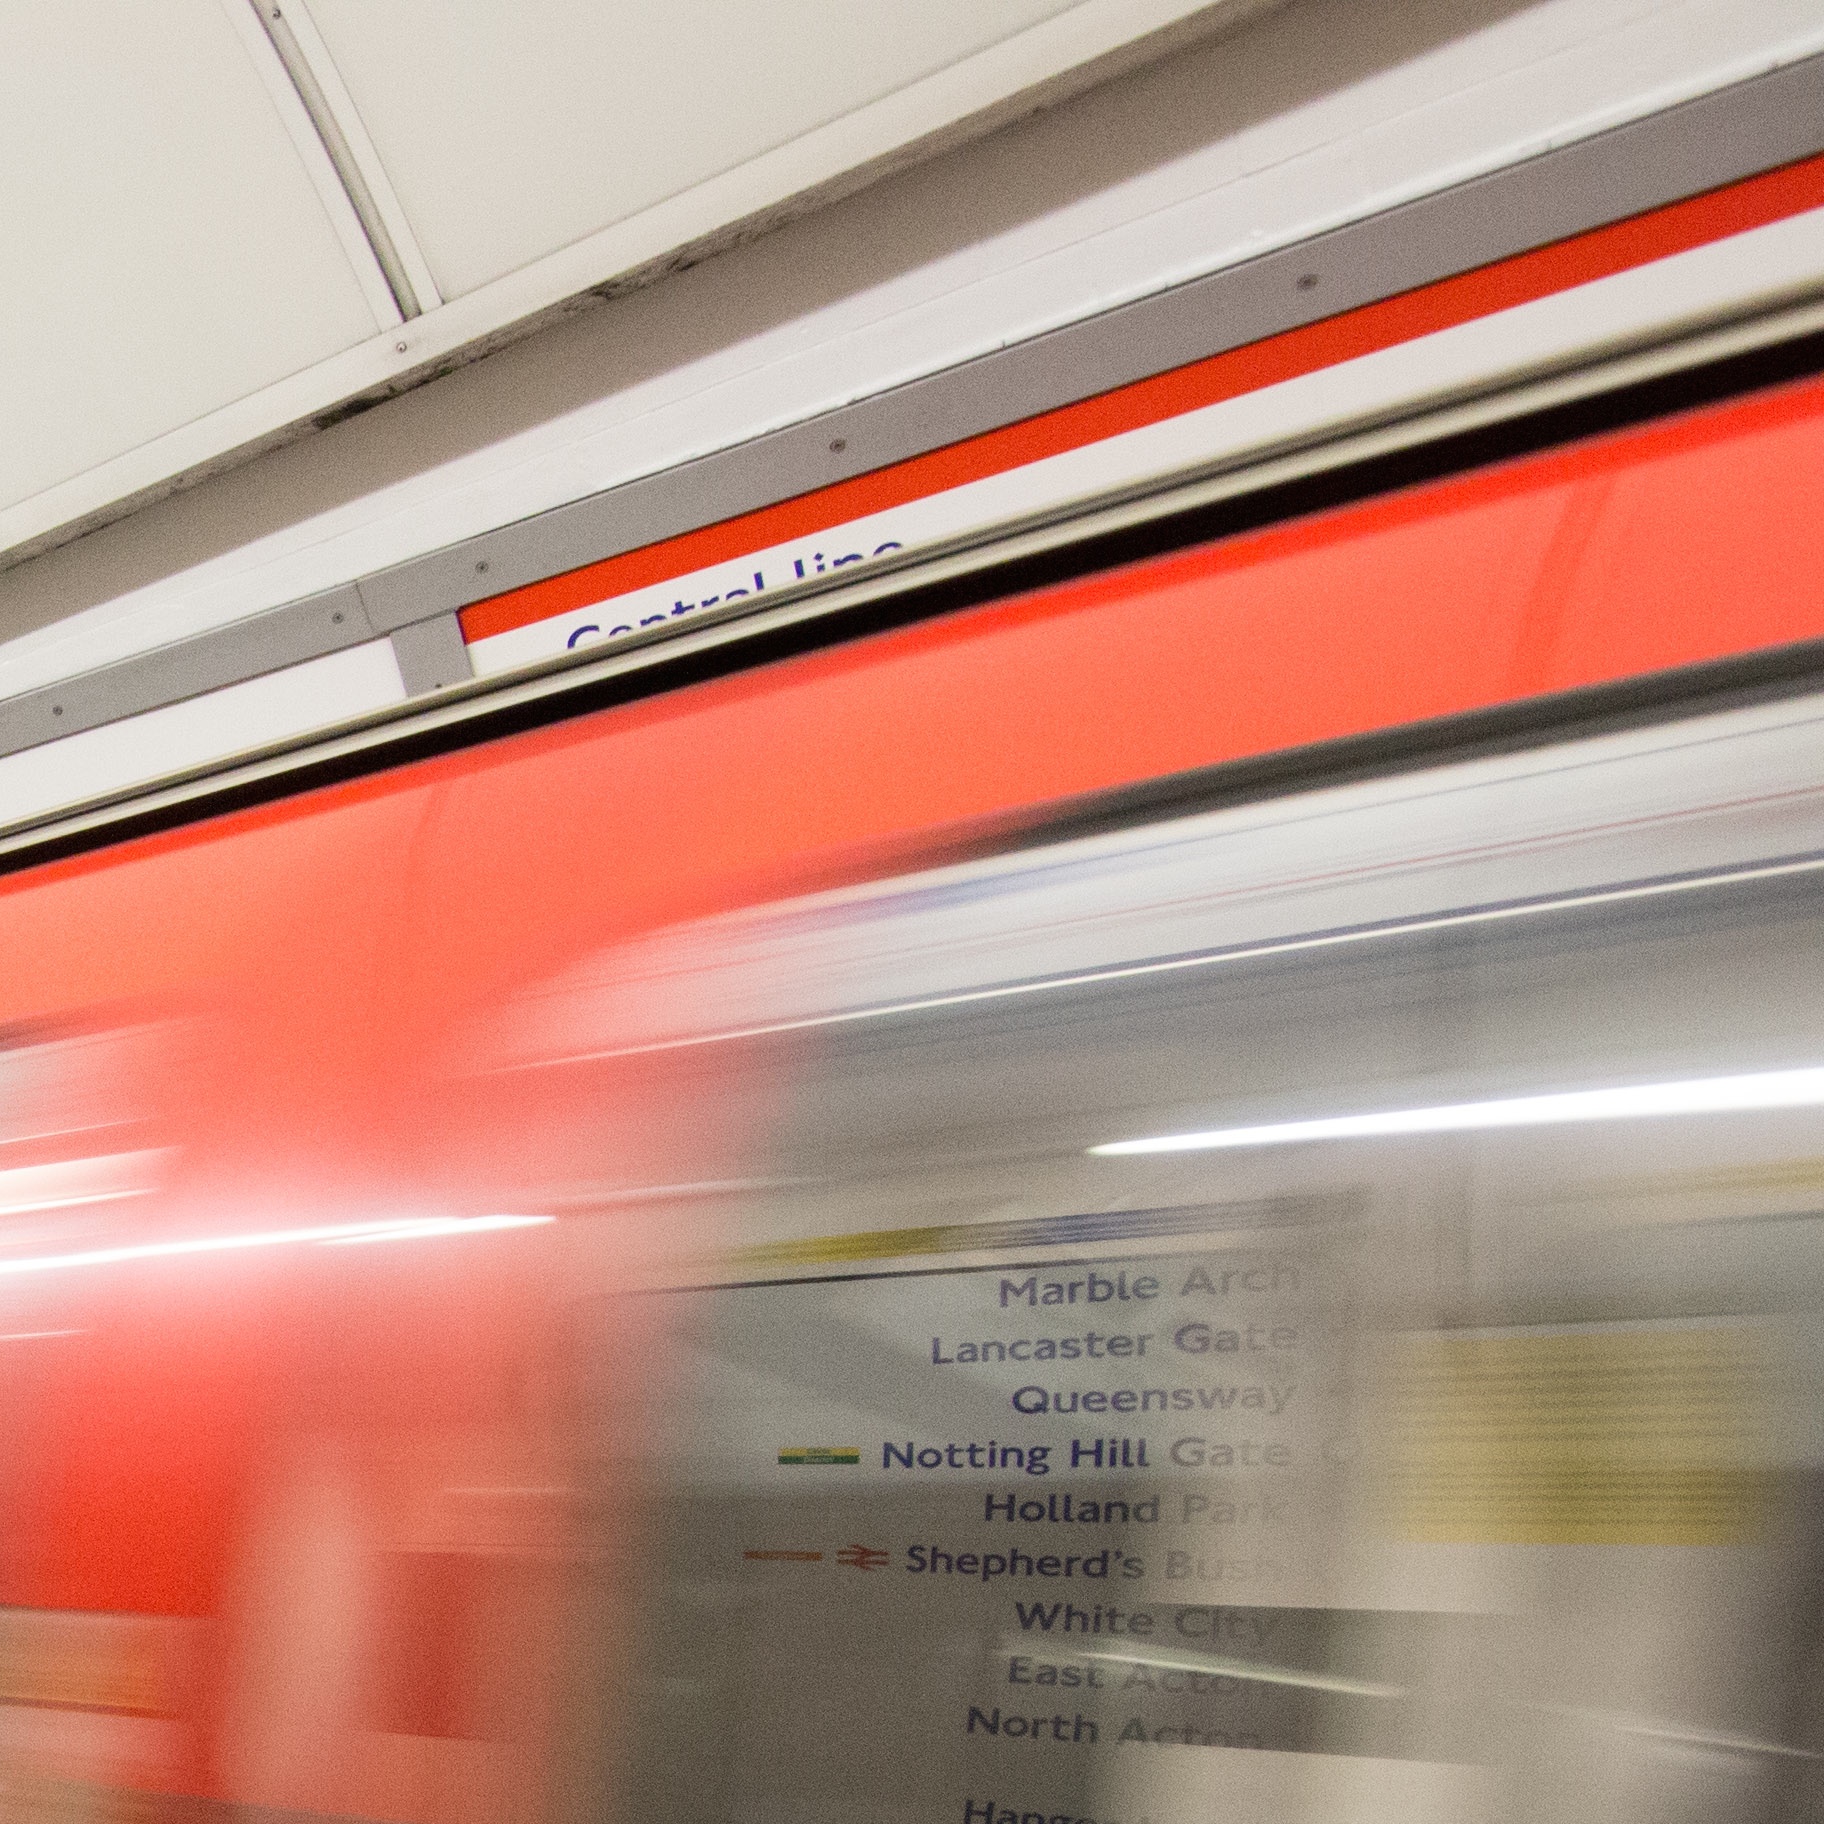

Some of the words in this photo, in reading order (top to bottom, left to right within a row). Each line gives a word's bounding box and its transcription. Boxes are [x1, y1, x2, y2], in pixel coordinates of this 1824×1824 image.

[999, 1272, 1159, 1308] Marble
[1180, 1264, 1301, 1297] Arch
[930, 1329, 1153, 1365] Lancaster
[1174, 1321, 1300, 1354] Gate
[1010, 1381, 1298, 1417] Queensway
[881, 1439, 1051, 1476] Notting
[1069, 1437, 1150, 1468] Hill
[1168, 1436, 1293, 1469] Gate
[983, 1493, 1160, 1525] Holland
[1181, 1493, 1288, 1526] Park
[905, 1545, 1145, 1581] Shepherd's
[1015, 1602, 1155, 1636] White
[1174, 1605, 1278, 1645] City
[1007, 1656, 1105, 1690] East
[966, 1705, 1100, 1744] North
